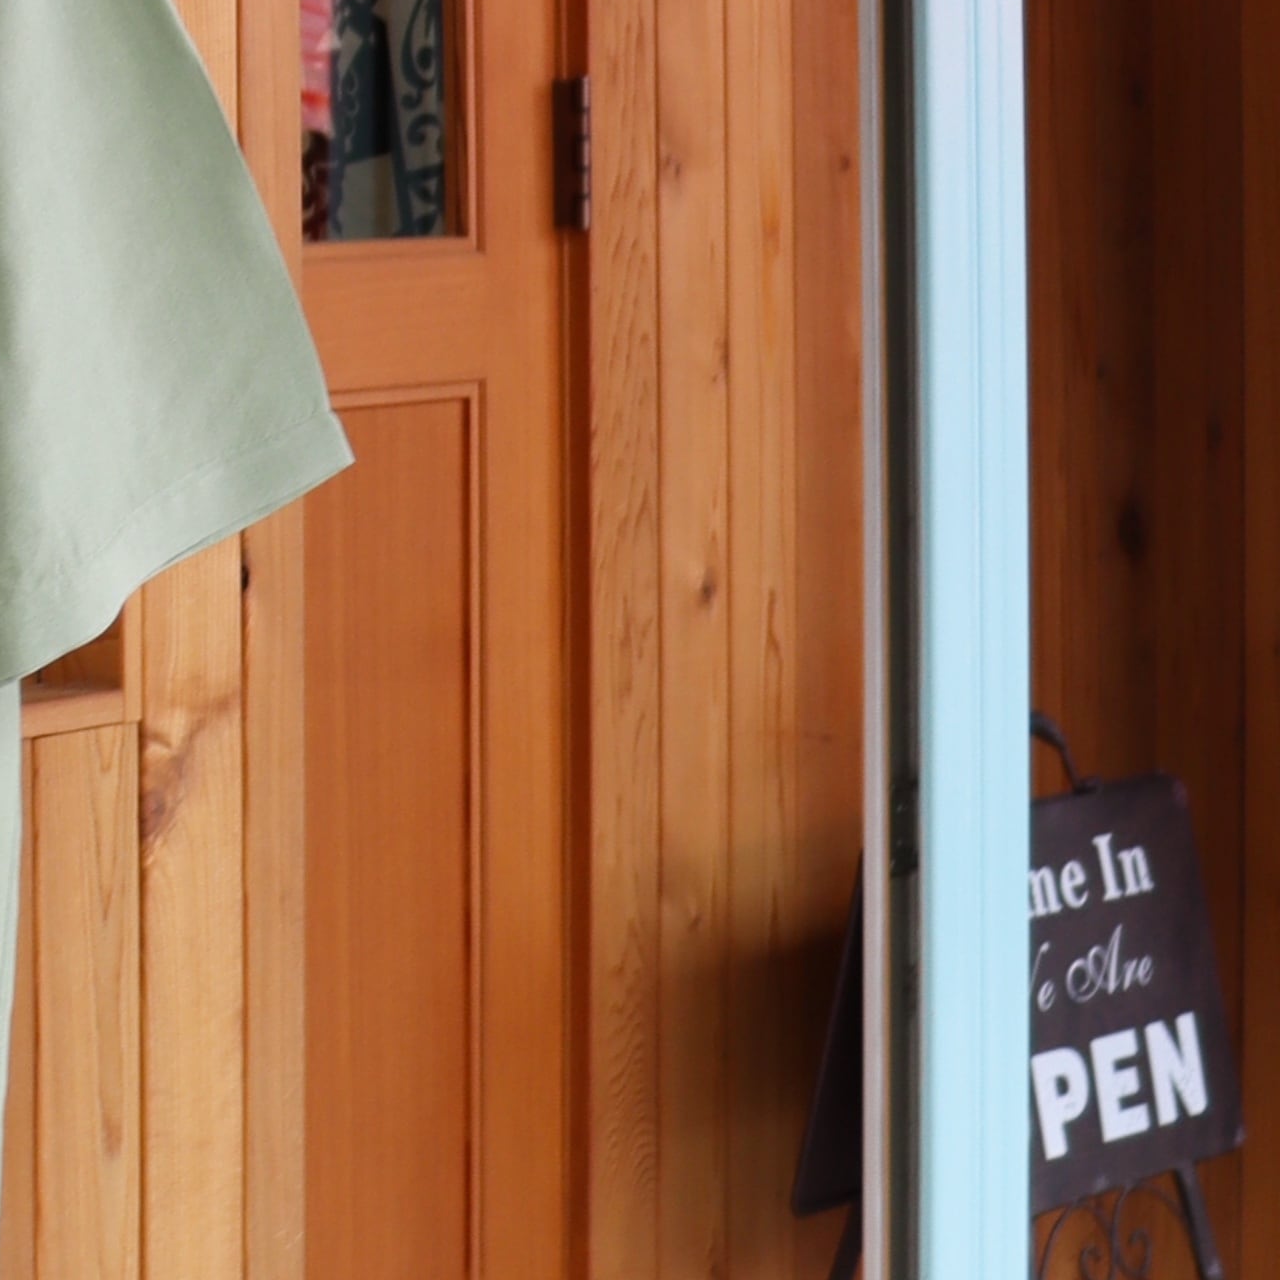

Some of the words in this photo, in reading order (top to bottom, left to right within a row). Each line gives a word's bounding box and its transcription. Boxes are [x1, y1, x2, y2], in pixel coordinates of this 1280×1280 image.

[1029, 858, 1089, 918] me
[1092, 833, 1154, 901] In
[1066, 924, 1153, 1002] Are
[1031, 1011, 1209, 1161] PEN
